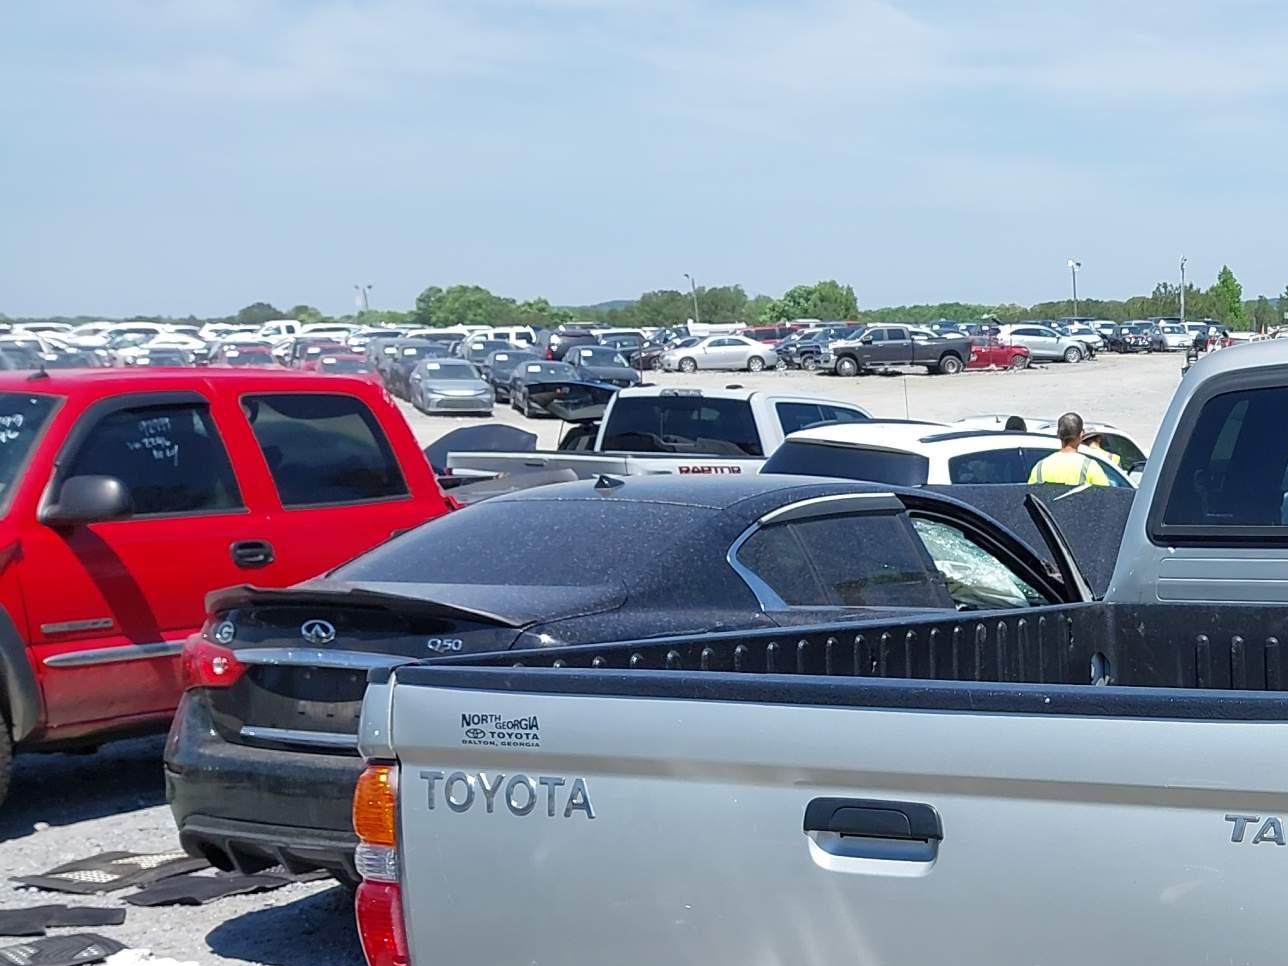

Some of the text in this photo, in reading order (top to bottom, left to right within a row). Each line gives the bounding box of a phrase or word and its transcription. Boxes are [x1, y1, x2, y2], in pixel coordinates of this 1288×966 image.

[678, 465, 742, 475] RAPTOR
[427, 638, 463, 654] Q50
[461, 713, 540, 732] NORTH GEORGIA
[489, 731, 540, 741] TOYOTA
[462, 739, 540, 748] DALTON, GEORGIA
[420, 770, 597, 820] TOYOTA
